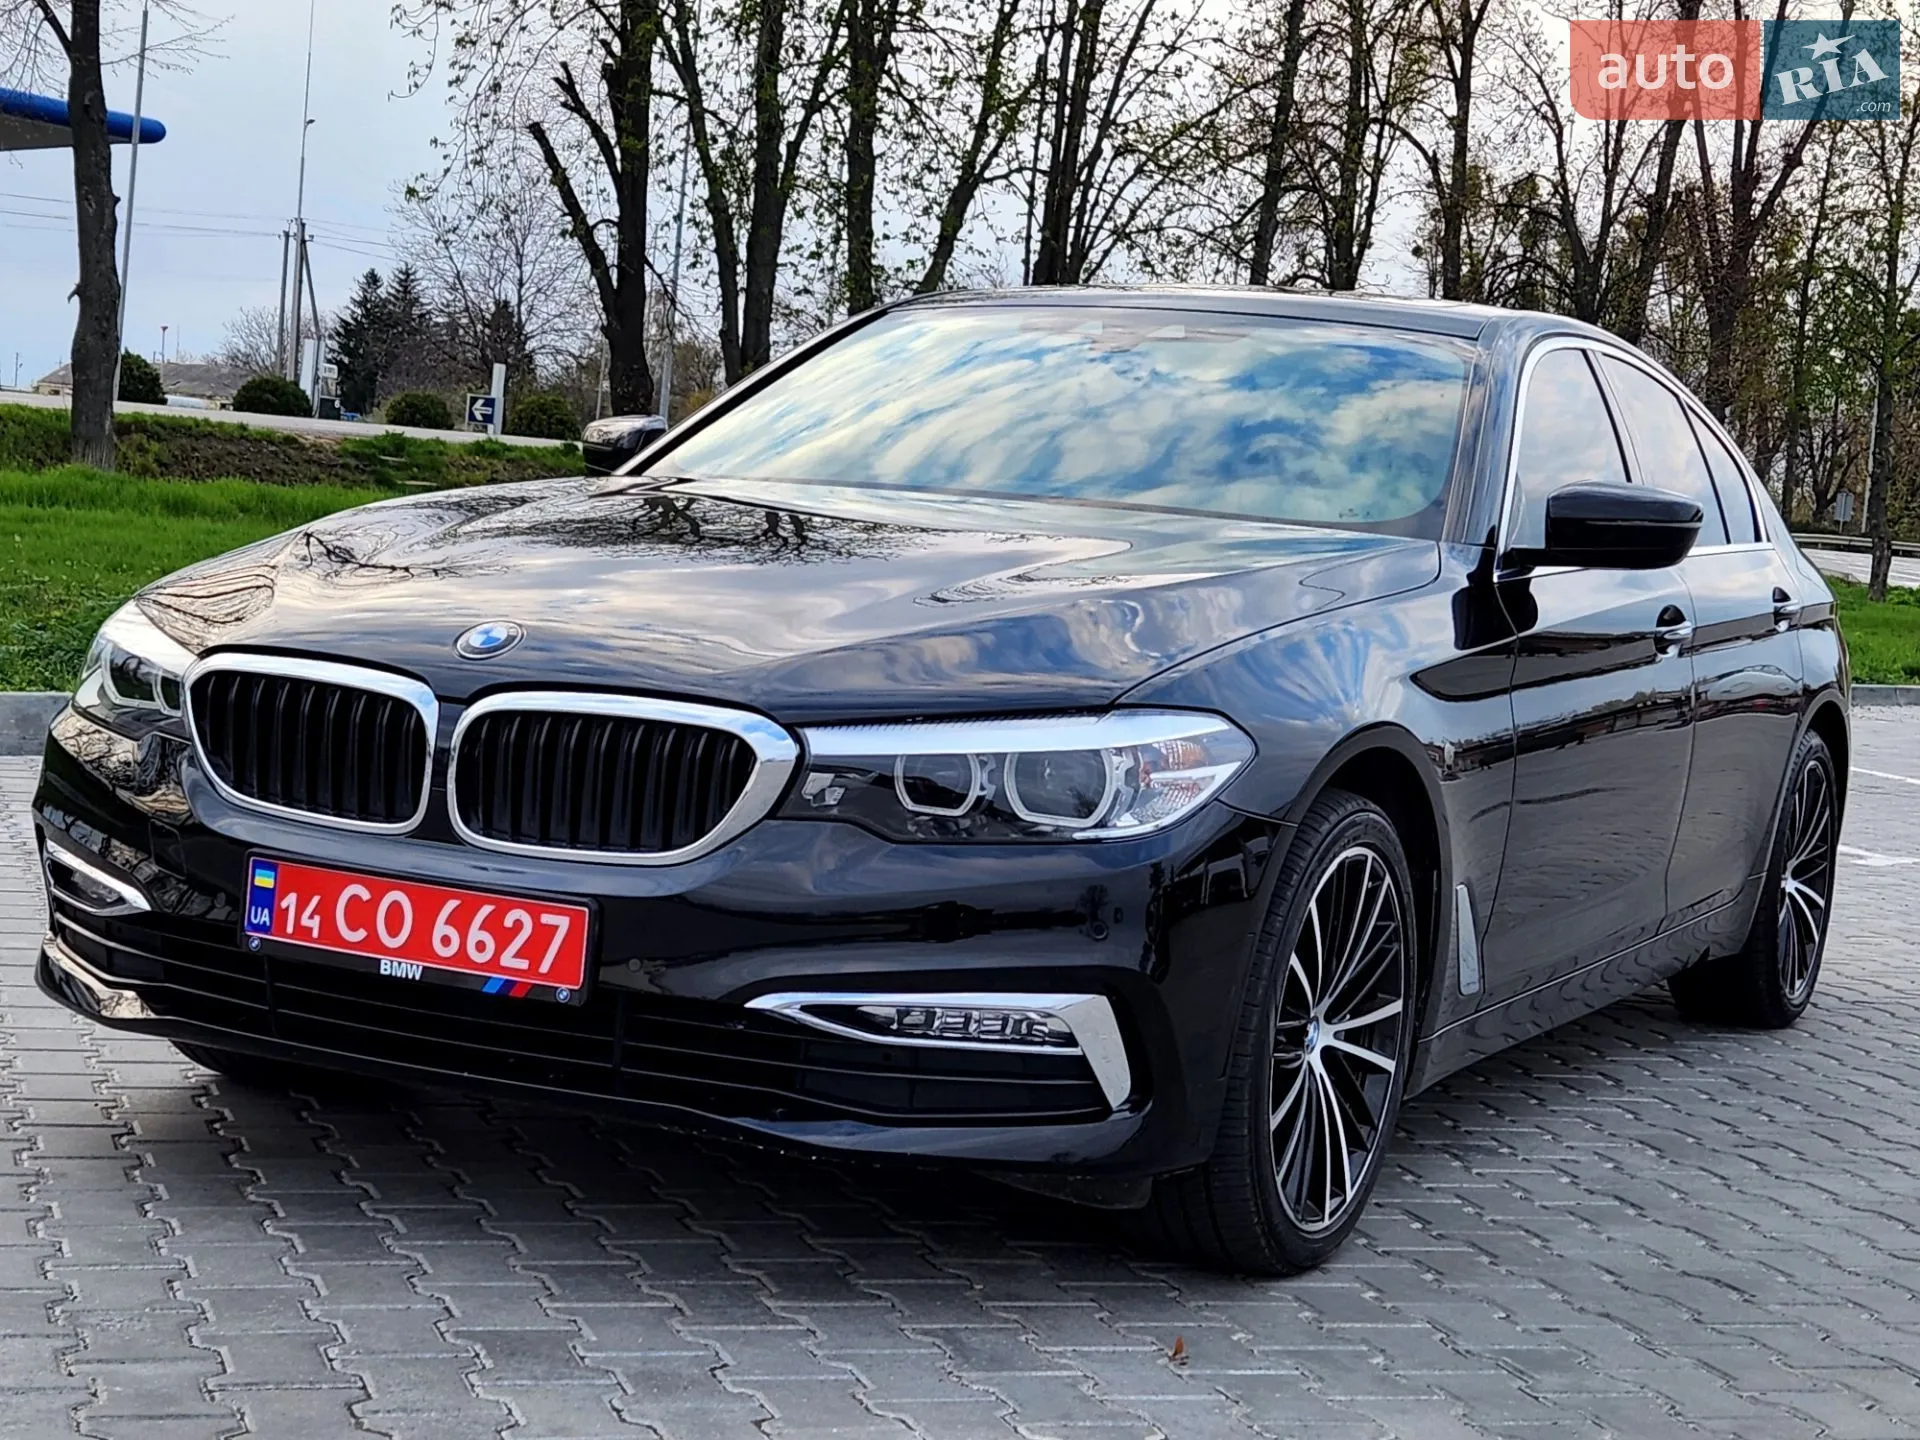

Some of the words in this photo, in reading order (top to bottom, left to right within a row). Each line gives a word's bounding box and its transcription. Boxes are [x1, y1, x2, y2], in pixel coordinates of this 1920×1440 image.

[250, 906, 270, 926] UA
[280, 892, 321, 939] 14
[335, 884, 413, 949] CO
[432, 899, 570, 974] 6627
[380, 959, 423, 980] BMW
